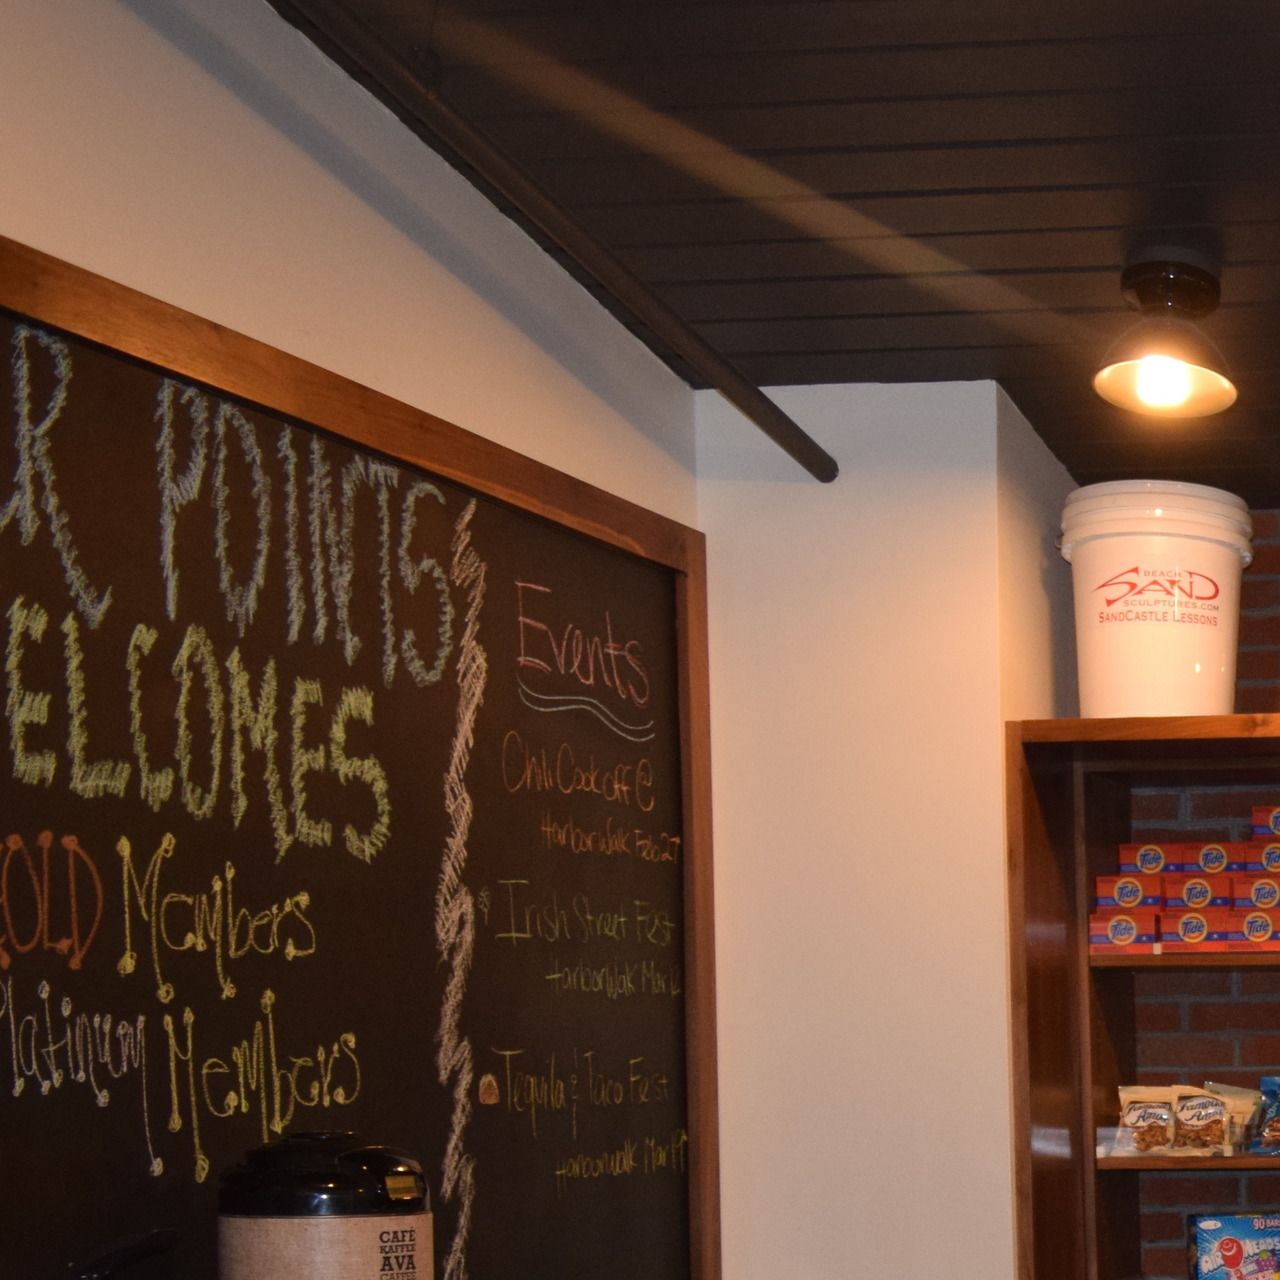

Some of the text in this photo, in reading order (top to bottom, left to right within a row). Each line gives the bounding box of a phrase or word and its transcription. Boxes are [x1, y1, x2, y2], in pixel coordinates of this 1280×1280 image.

[0, 325, 112, 630] R
[1143, 569, 1182, 578] BEACH
[1090, 565, 1220, 608] SAND
[513, 580, 651, 709] Events
[1139, 851, 1162, 866] Tide
[1202, 851, 1225, 865] Tide
[1117, 885, 1140, 899] Tide
[1185, 886, 1209, 900] Tide
[1254, 886, 1278, 901] Tide
[0, 830, 316, 1003] OLD Members
[1111, 923, 1134, 937] Tide
[1181, 920, 1205, 935] Tide
[1246, 920, 1270, 935] Tide
[0, 975, 361, 1184] latinum Members
[380, 1244, 417, 1255] KAFFEE
[380, 1254, 417, 1272] AVA
